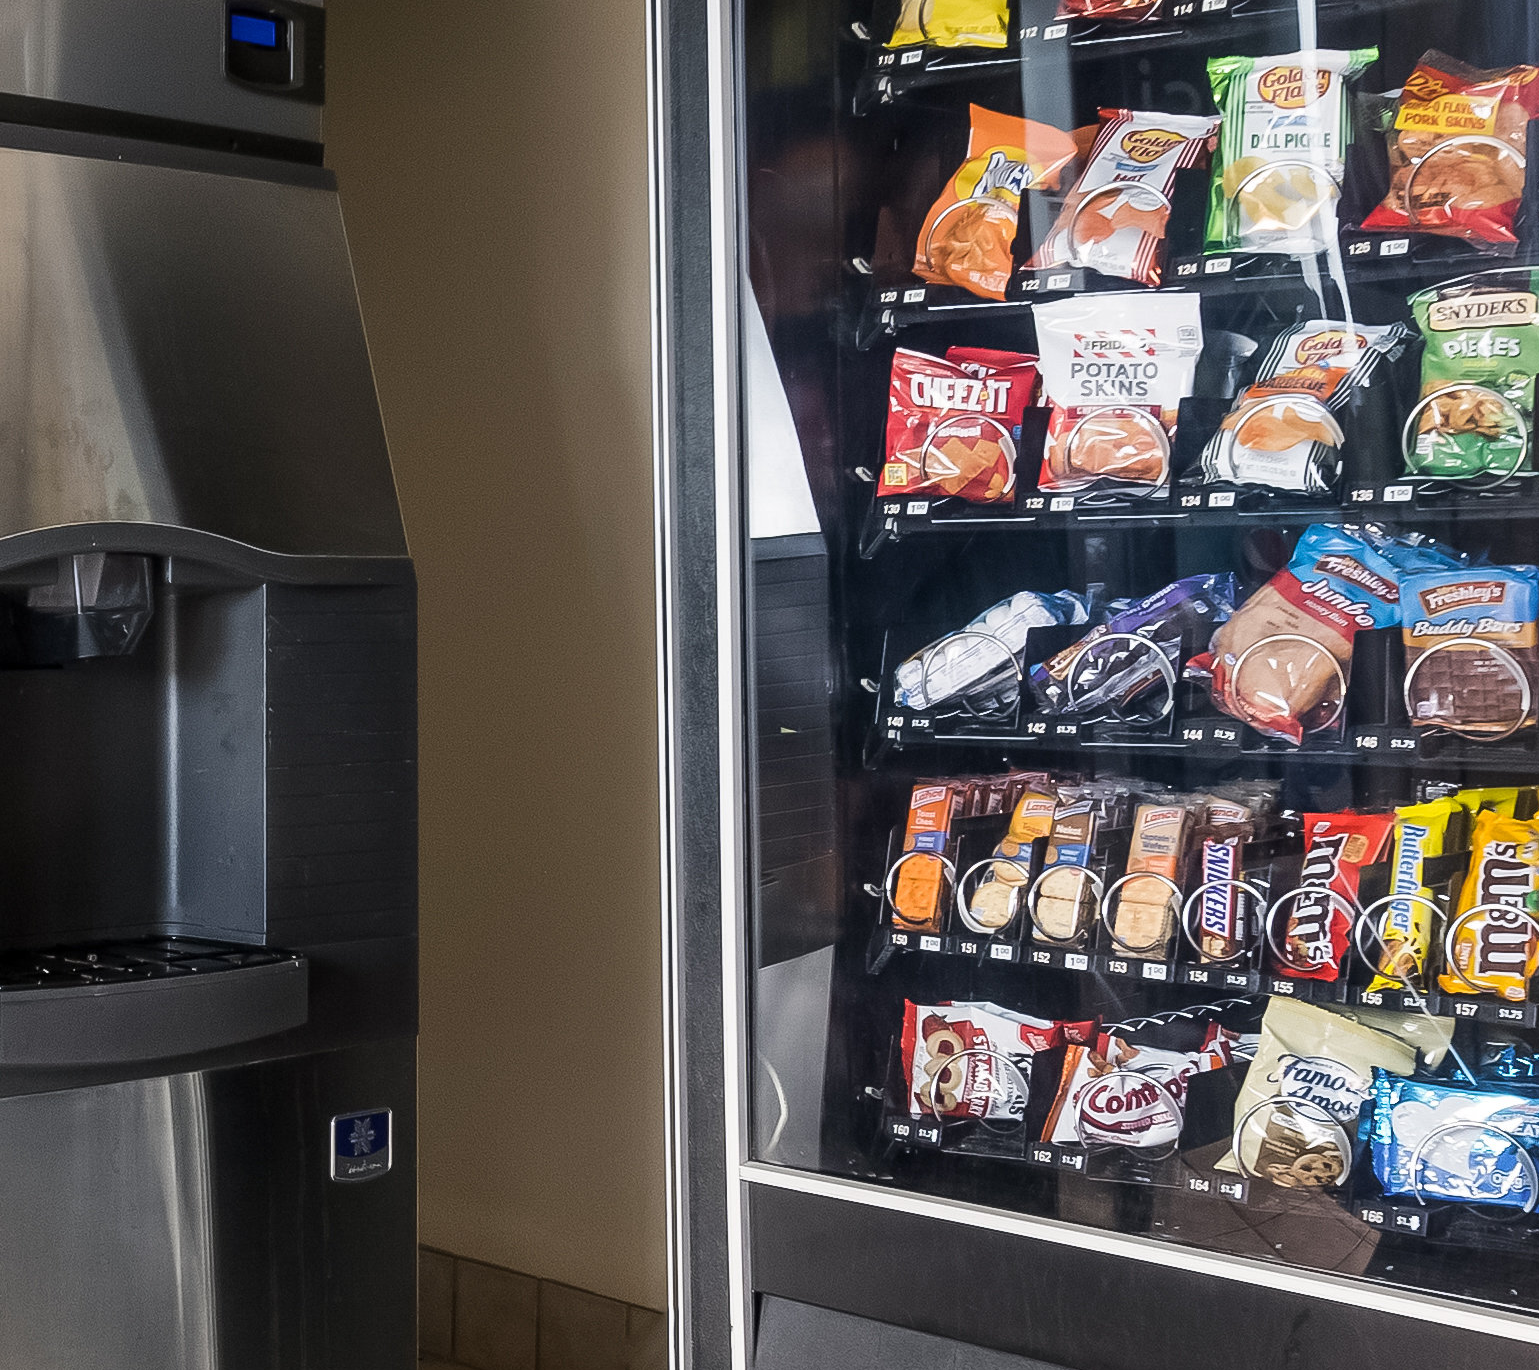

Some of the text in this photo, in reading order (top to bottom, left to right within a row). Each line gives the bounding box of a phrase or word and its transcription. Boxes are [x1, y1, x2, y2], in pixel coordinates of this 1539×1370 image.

[1263, 69, 1326, 88] Goldn
[1271, 83, 1325, 102] Flae
[1071, 362, 1158, 379] POTATO
[1081, 379, 1148, 397] SKINS
[1301, 579, 1374, 627] Jumbo
[1412, 618, 1475, 637] Buddy
[1025, 802, 1054, 813] Lanc
[1209, 808, 1240, 818] ance
[961, 943, 977, 954] 151
[1033, 952, 1051, 963] 152
[1108, 961, 1127, 973] 153
[1273, 981, 1294, 994] 155
[1454, 1004, 1478, 1016] 157
[1033, 1151, 1052, 1163] 162
